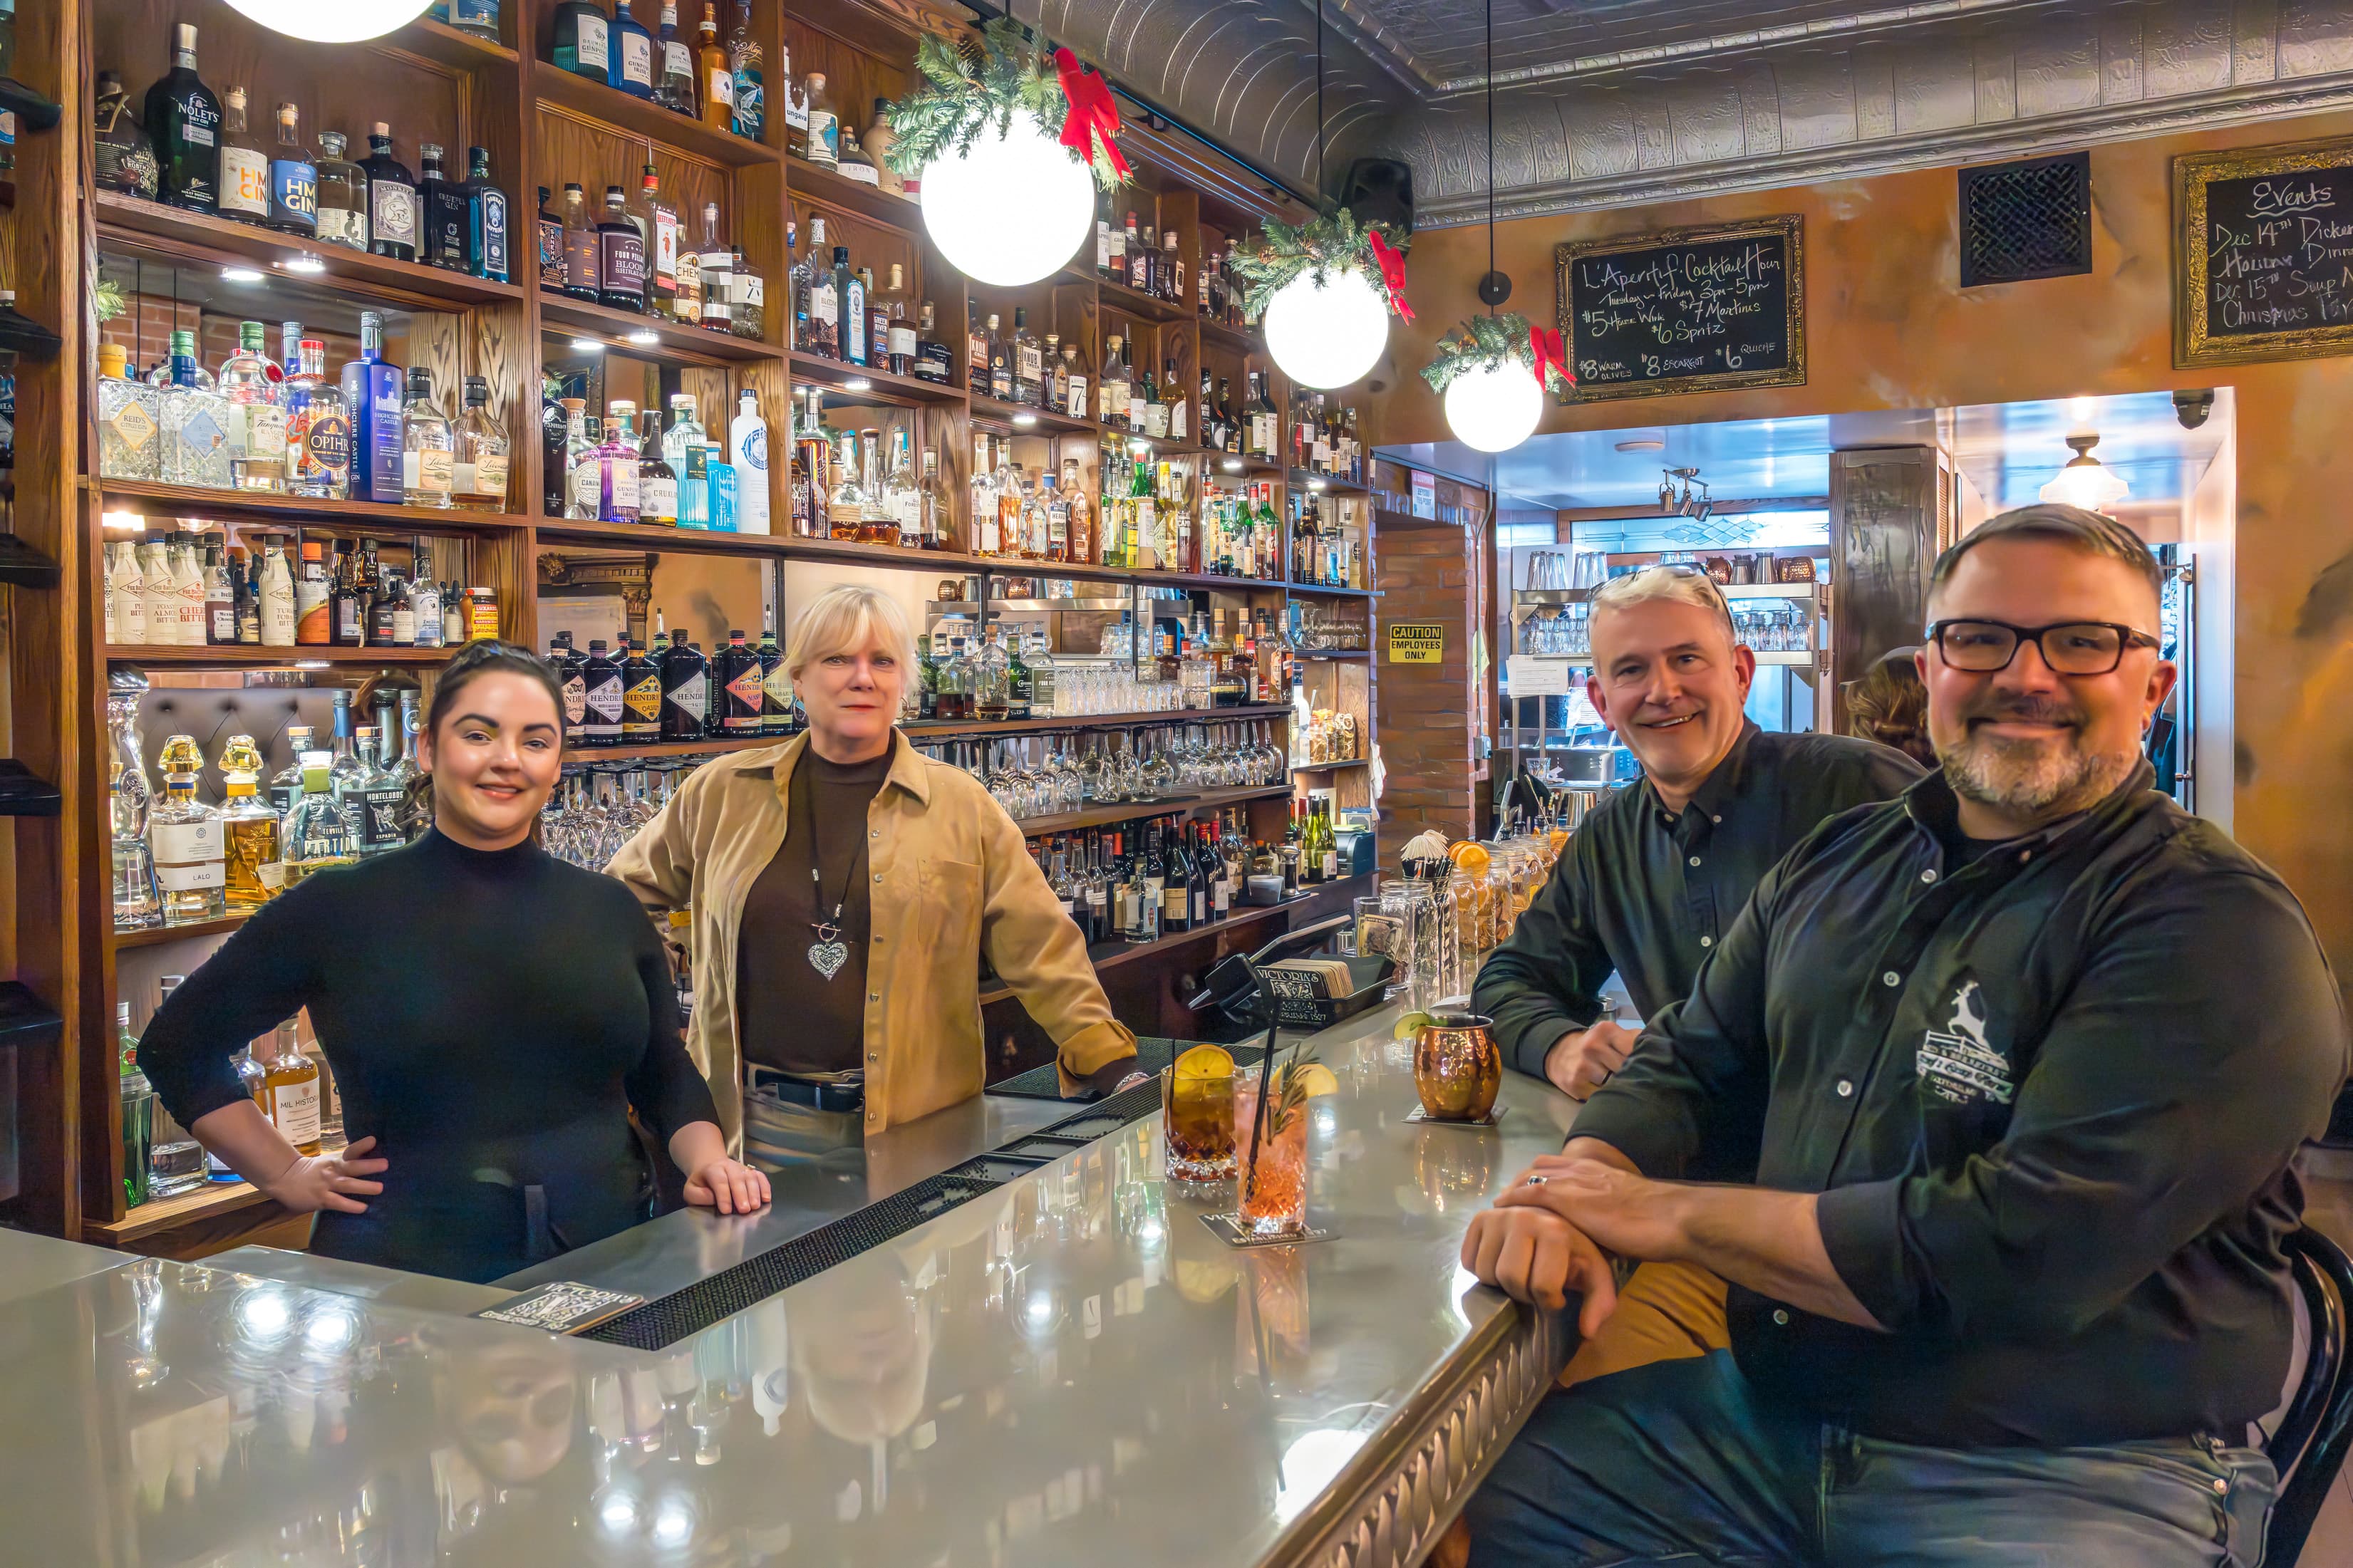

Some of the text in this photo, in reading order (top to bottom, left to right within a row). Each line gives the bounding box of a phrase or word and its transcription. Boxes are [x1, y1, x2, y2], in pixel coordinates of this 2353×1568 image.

[178, 103, 219, 123] NOLET'S
[787, 108, 807, 122] ungava
[240, 167, 267, 186] HM
[239, 184, 267, 203] GIN
[286, 178, 316, 198] HM
[2253, 181, 2332, 211] Events
[285, 195, 316, 214] GIN
[445, 202, 458, 210] GIN
[2209, 223, 2252, 257] Dec
[615, 251, 630, 259] FOUR
[1685, 253, 1741, 283] Cocktail
[1743, 243, 1780, 281] Hour
[1598, 289, 1645, 309] Tuesday
[1658, 283, 1694, 301] Friday
[1581, 309, 1608, 337] $5
[1638, 304, 1665, 323] Wine
[1680, 300, 1704, 323] $7
[2223, 298, 2310, 328] Christmas
[874, 323, 887, 333] RIVER
[1651, 320, 1725, 344] $6 Spritz
[971, 339, 986, 355] KNOB
[1715, 341, 1776, 369] $6 QUICHE
[1023, 351, 1038, 365] KNOB
[1641, 353, 1705, 377] $8 ESCARGOT
[1578, 359, 1625, 380] $8 WARM
[1601, 370, 1633, 380] OLIVES
[123, 415, 146, 424] REID'S
[311, 435, 349, 452] OPIHR
[1392, 627, 1440, 638] CAUTION
[1391, 640, 1441, 649] EMPLOYEES
[1405, 651, 1427, 660] ONLY
[366, 791, 403, 801] MONTELOBOS
[1256, 968, 1319, 983] VICTORIA'S
[280, 1101, 294, 1109] MIL
[544, 1282, 638, 1304] VICTORIA'S
